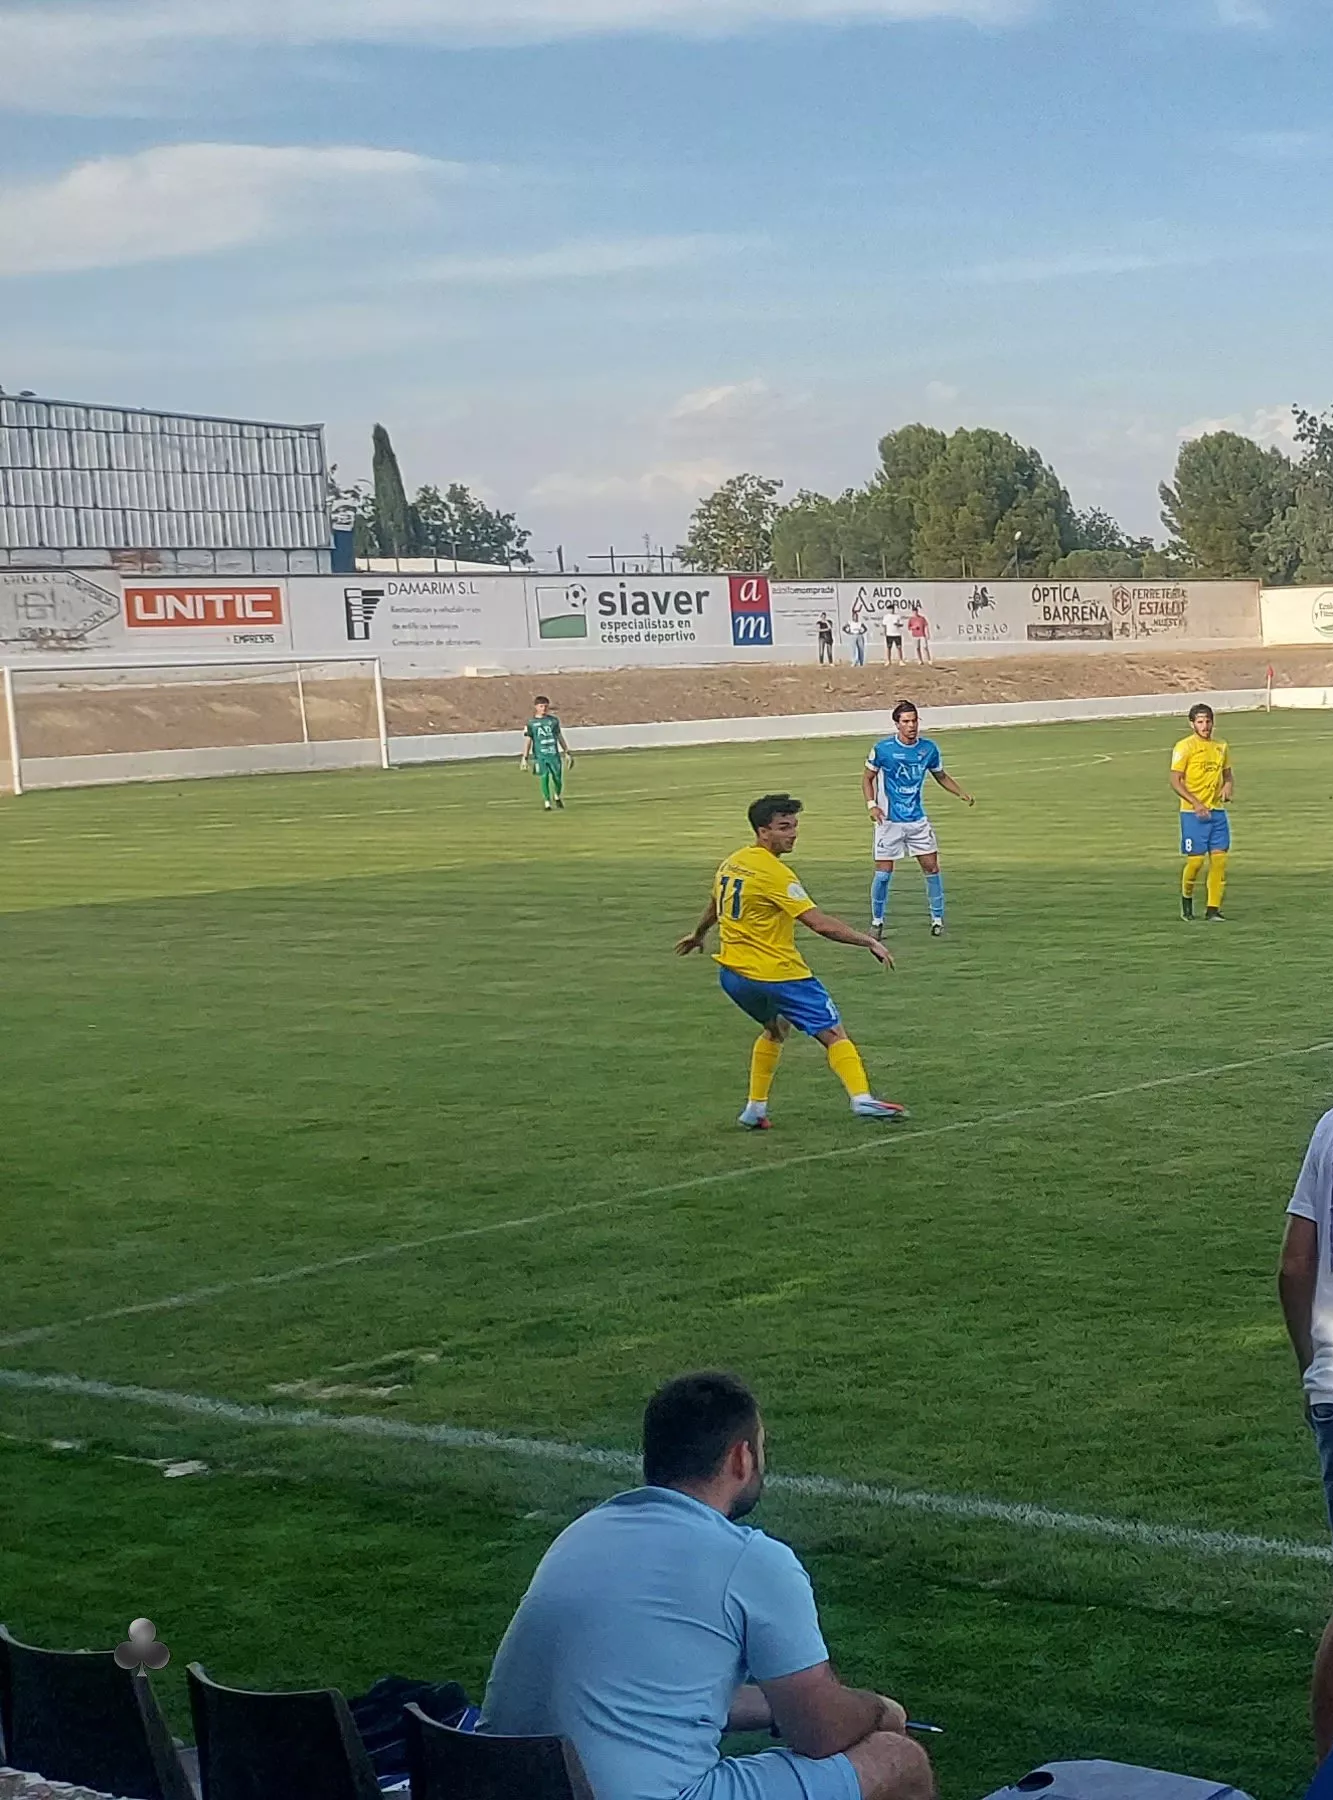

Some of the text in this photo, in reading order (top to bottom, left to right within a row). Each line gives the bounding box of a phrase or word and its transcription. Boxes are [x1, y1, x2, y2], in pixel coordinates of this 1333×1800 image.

[388, 581, 455, 596] DAMARIM
[872, 586, 902, 598] AUTO
[1031, 584, 1081, 603] ÓPTICA
[134, 593, 274, 620] UNITIC
[598, 582, 710, 616] siaver
[1042, 602, 1110, 622] BARREÑA
[600, 618, 691, 633] especialistas en
[735, 615, 770, 639] m
[958, 623, 1009, 635] BORSAO
[233, 633, 275, 645] EMPRESAS
[601, 630, 696, 645] césped deportivo
[1184, 838, 1193, 852] 8
[719, 875, 744, 919] 11
